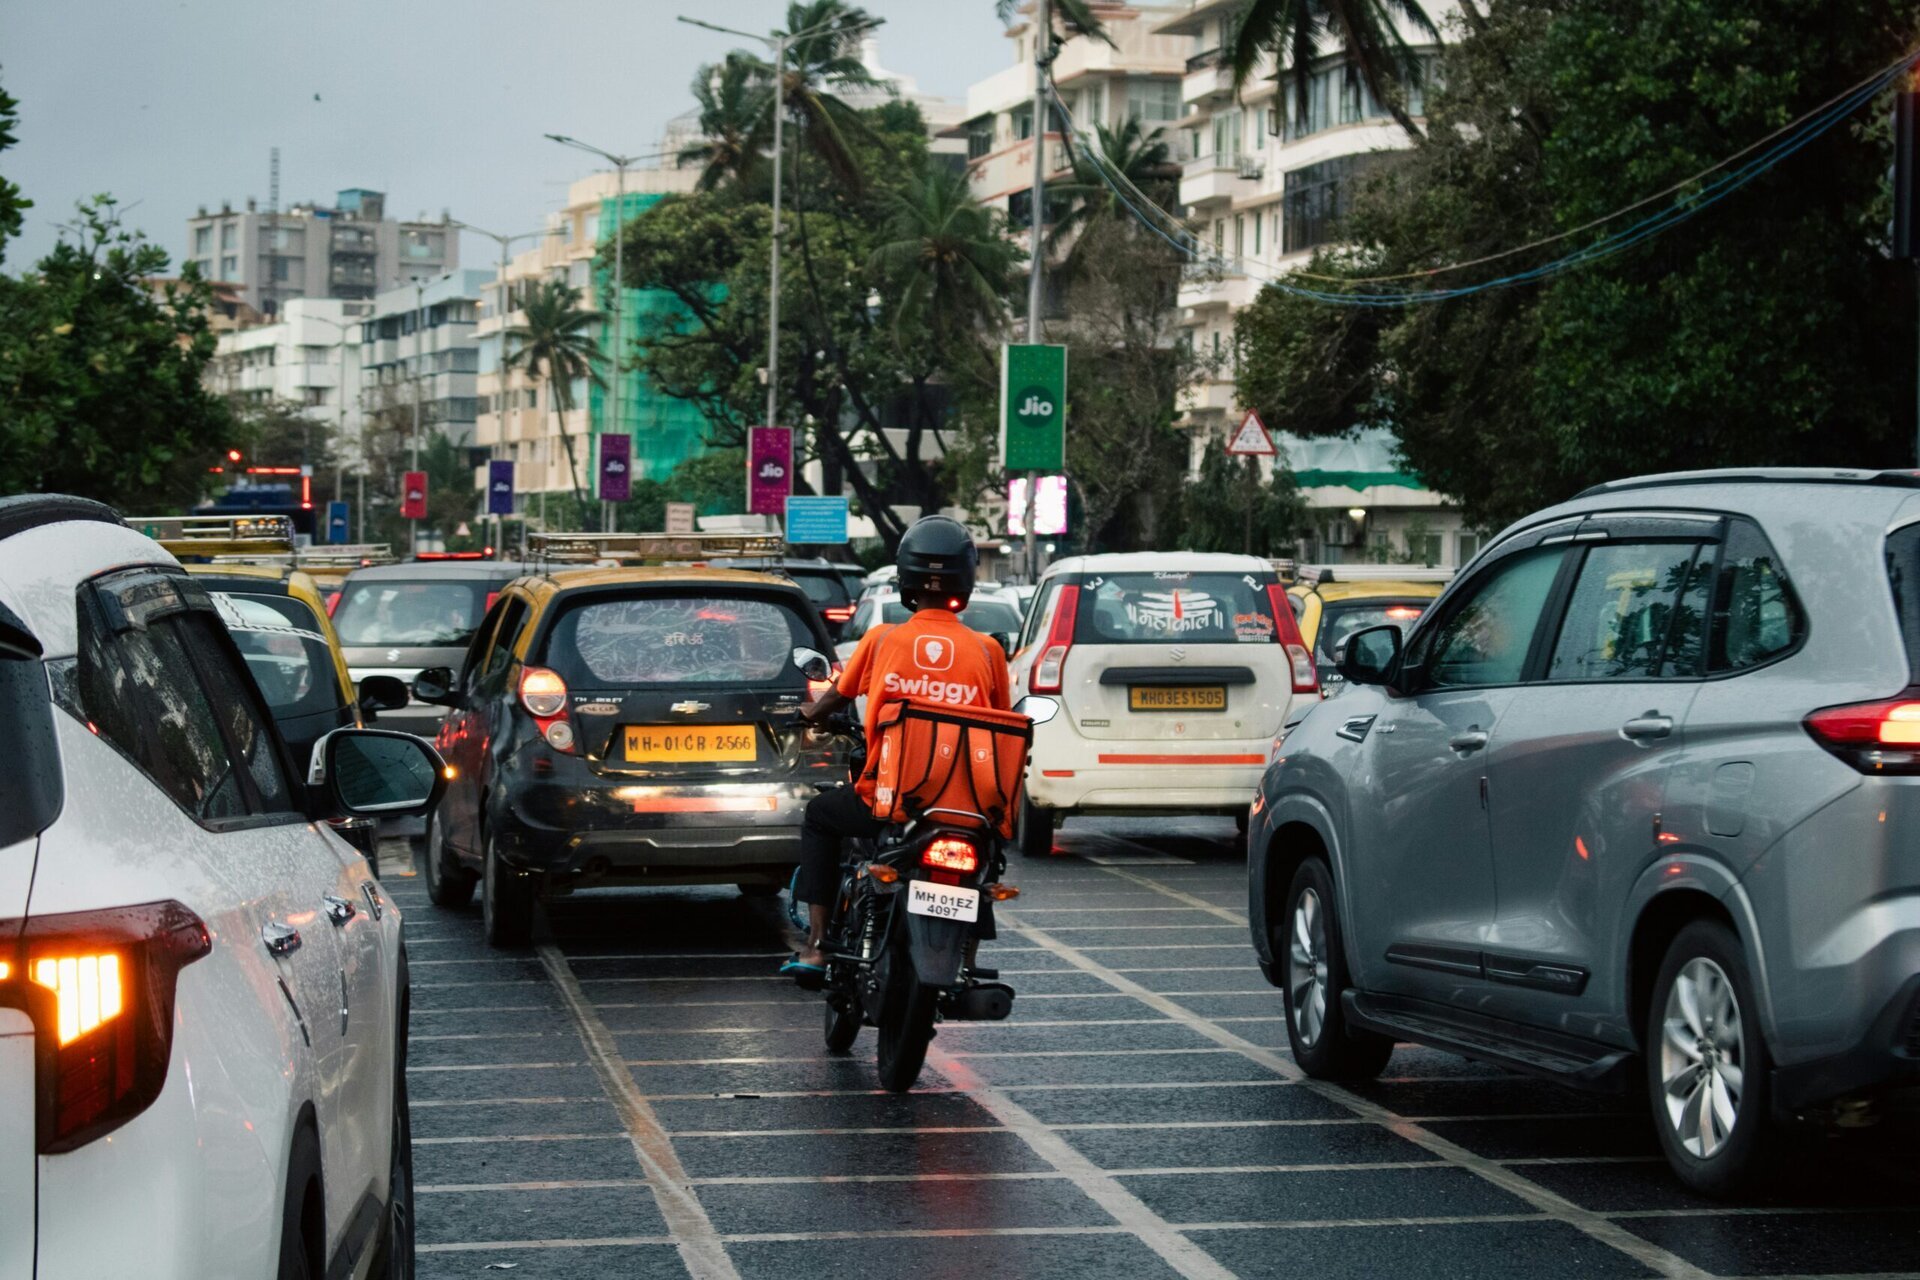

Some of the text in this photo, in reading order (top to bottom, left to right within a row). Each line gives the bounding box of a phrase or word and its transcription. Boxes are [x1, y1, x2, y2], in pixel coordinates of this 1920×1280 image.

[1018, 395, 1053, 416] Jio
[605, 460, 626, 473] Jio
[759, 462, 785, 478] Jio
[884, 672, 979, 706] Swiggy
[1140, 690, 1223, 706] MH03ES1505
[915, 890, 974, 910] MH 01EZ
[927, 904, 959, 918] 4097
